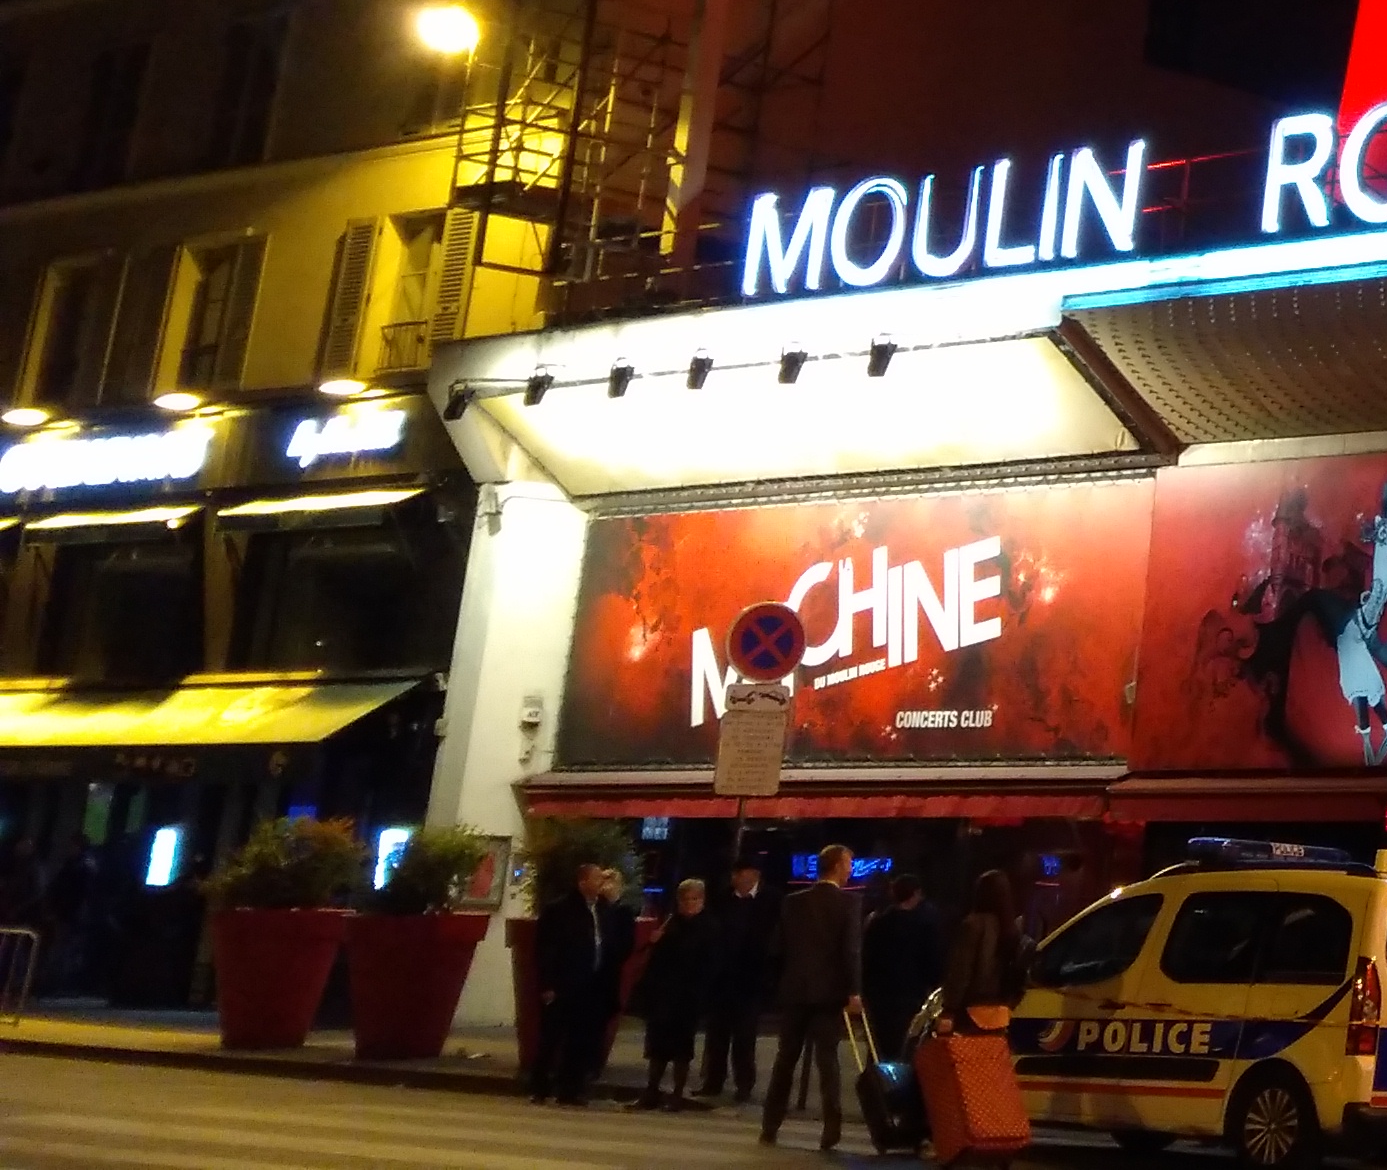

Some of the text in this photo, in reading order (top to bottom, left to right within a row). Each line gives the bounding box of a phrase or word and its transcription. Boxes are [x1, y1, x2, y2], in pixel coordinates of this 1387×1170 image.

[739, 137, 1147, 297] MOULIN
[690, 534, 1002, 728] MCHINE
[895, 709, 993, 729] CONCERTS CLUB
[1076, 1020, 1213, 1055] POLICE
